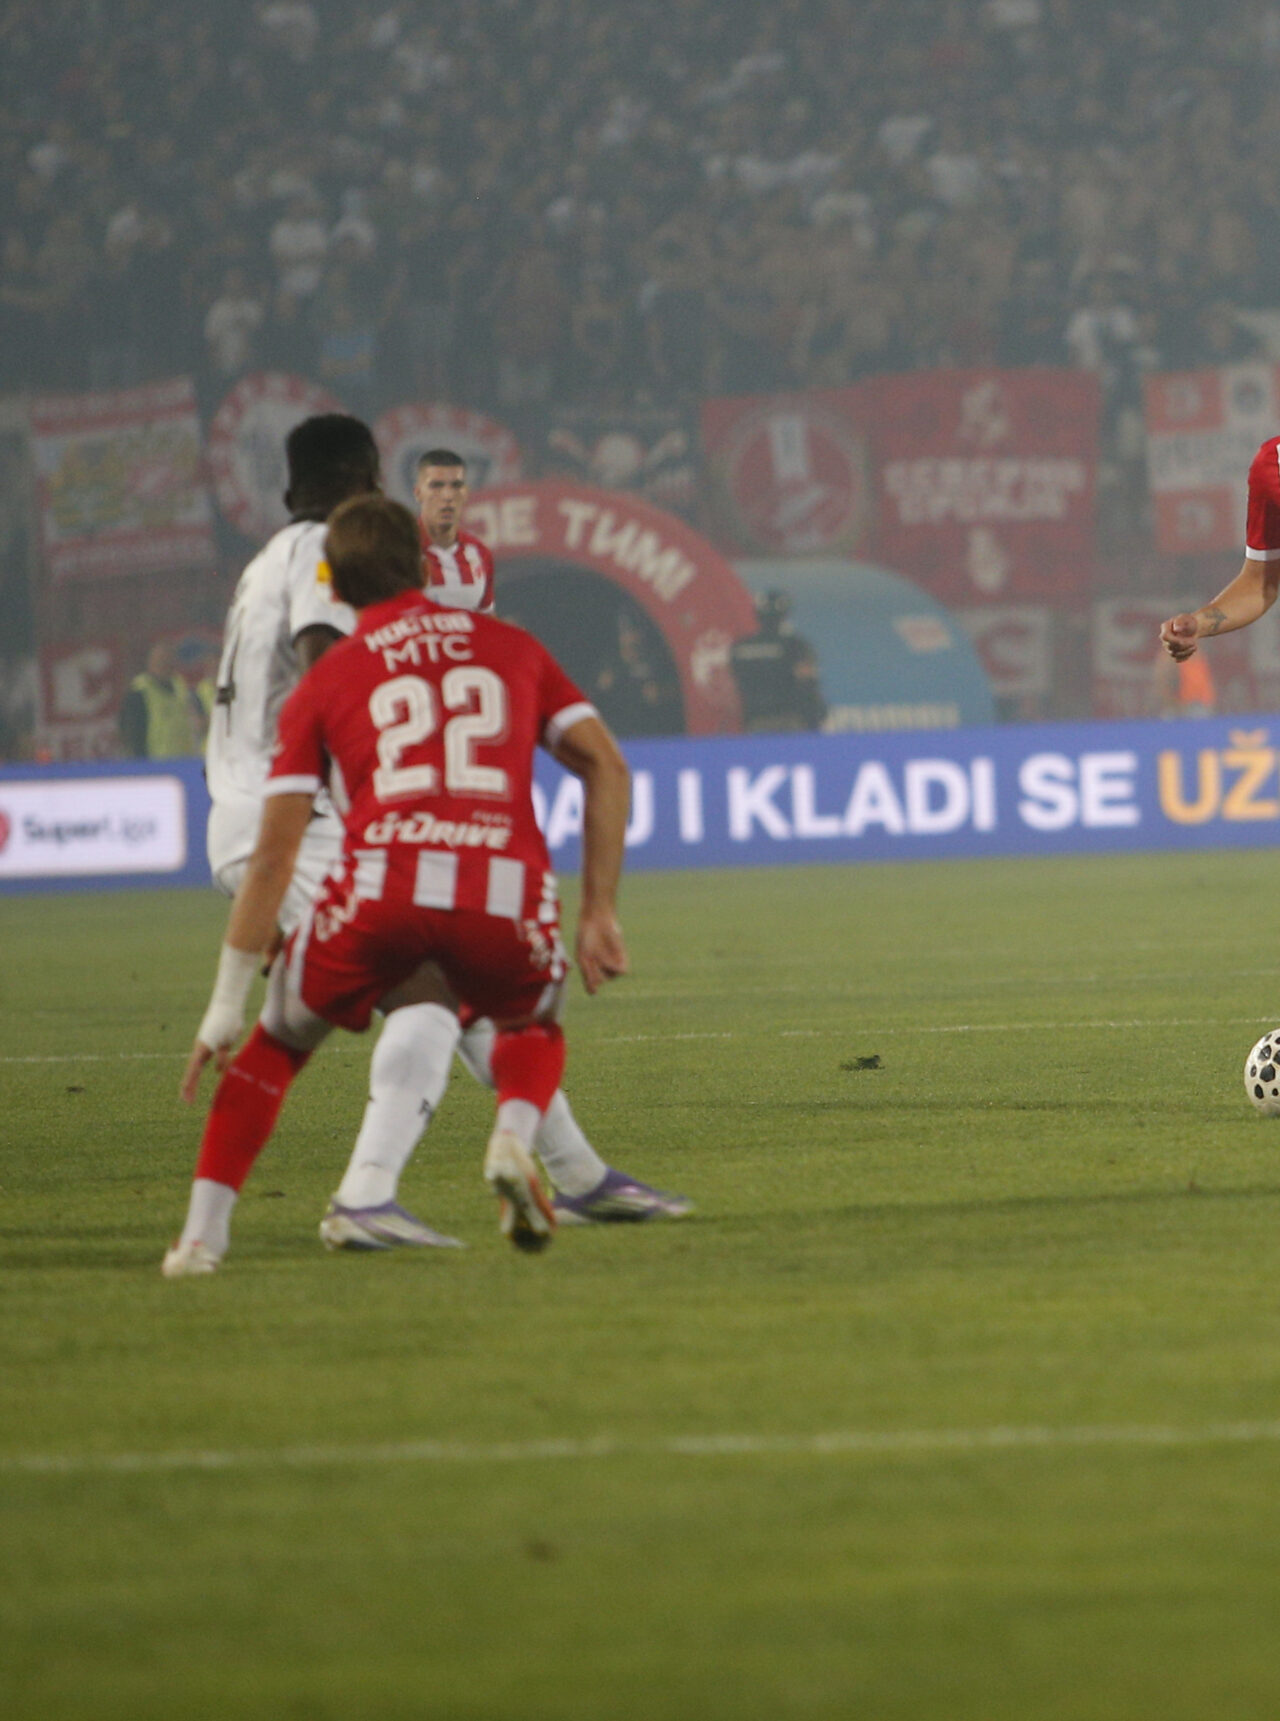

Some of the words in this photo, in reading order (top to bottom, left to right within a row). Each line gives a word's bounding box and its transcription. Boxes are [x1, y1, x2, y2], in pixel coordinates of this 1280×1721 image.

[369, 665, 512, 803] 22
[679, 768, 704, 843] I
[727, 756, 996, 842] KLADI
[1018, 752, 1142, 831] SE
